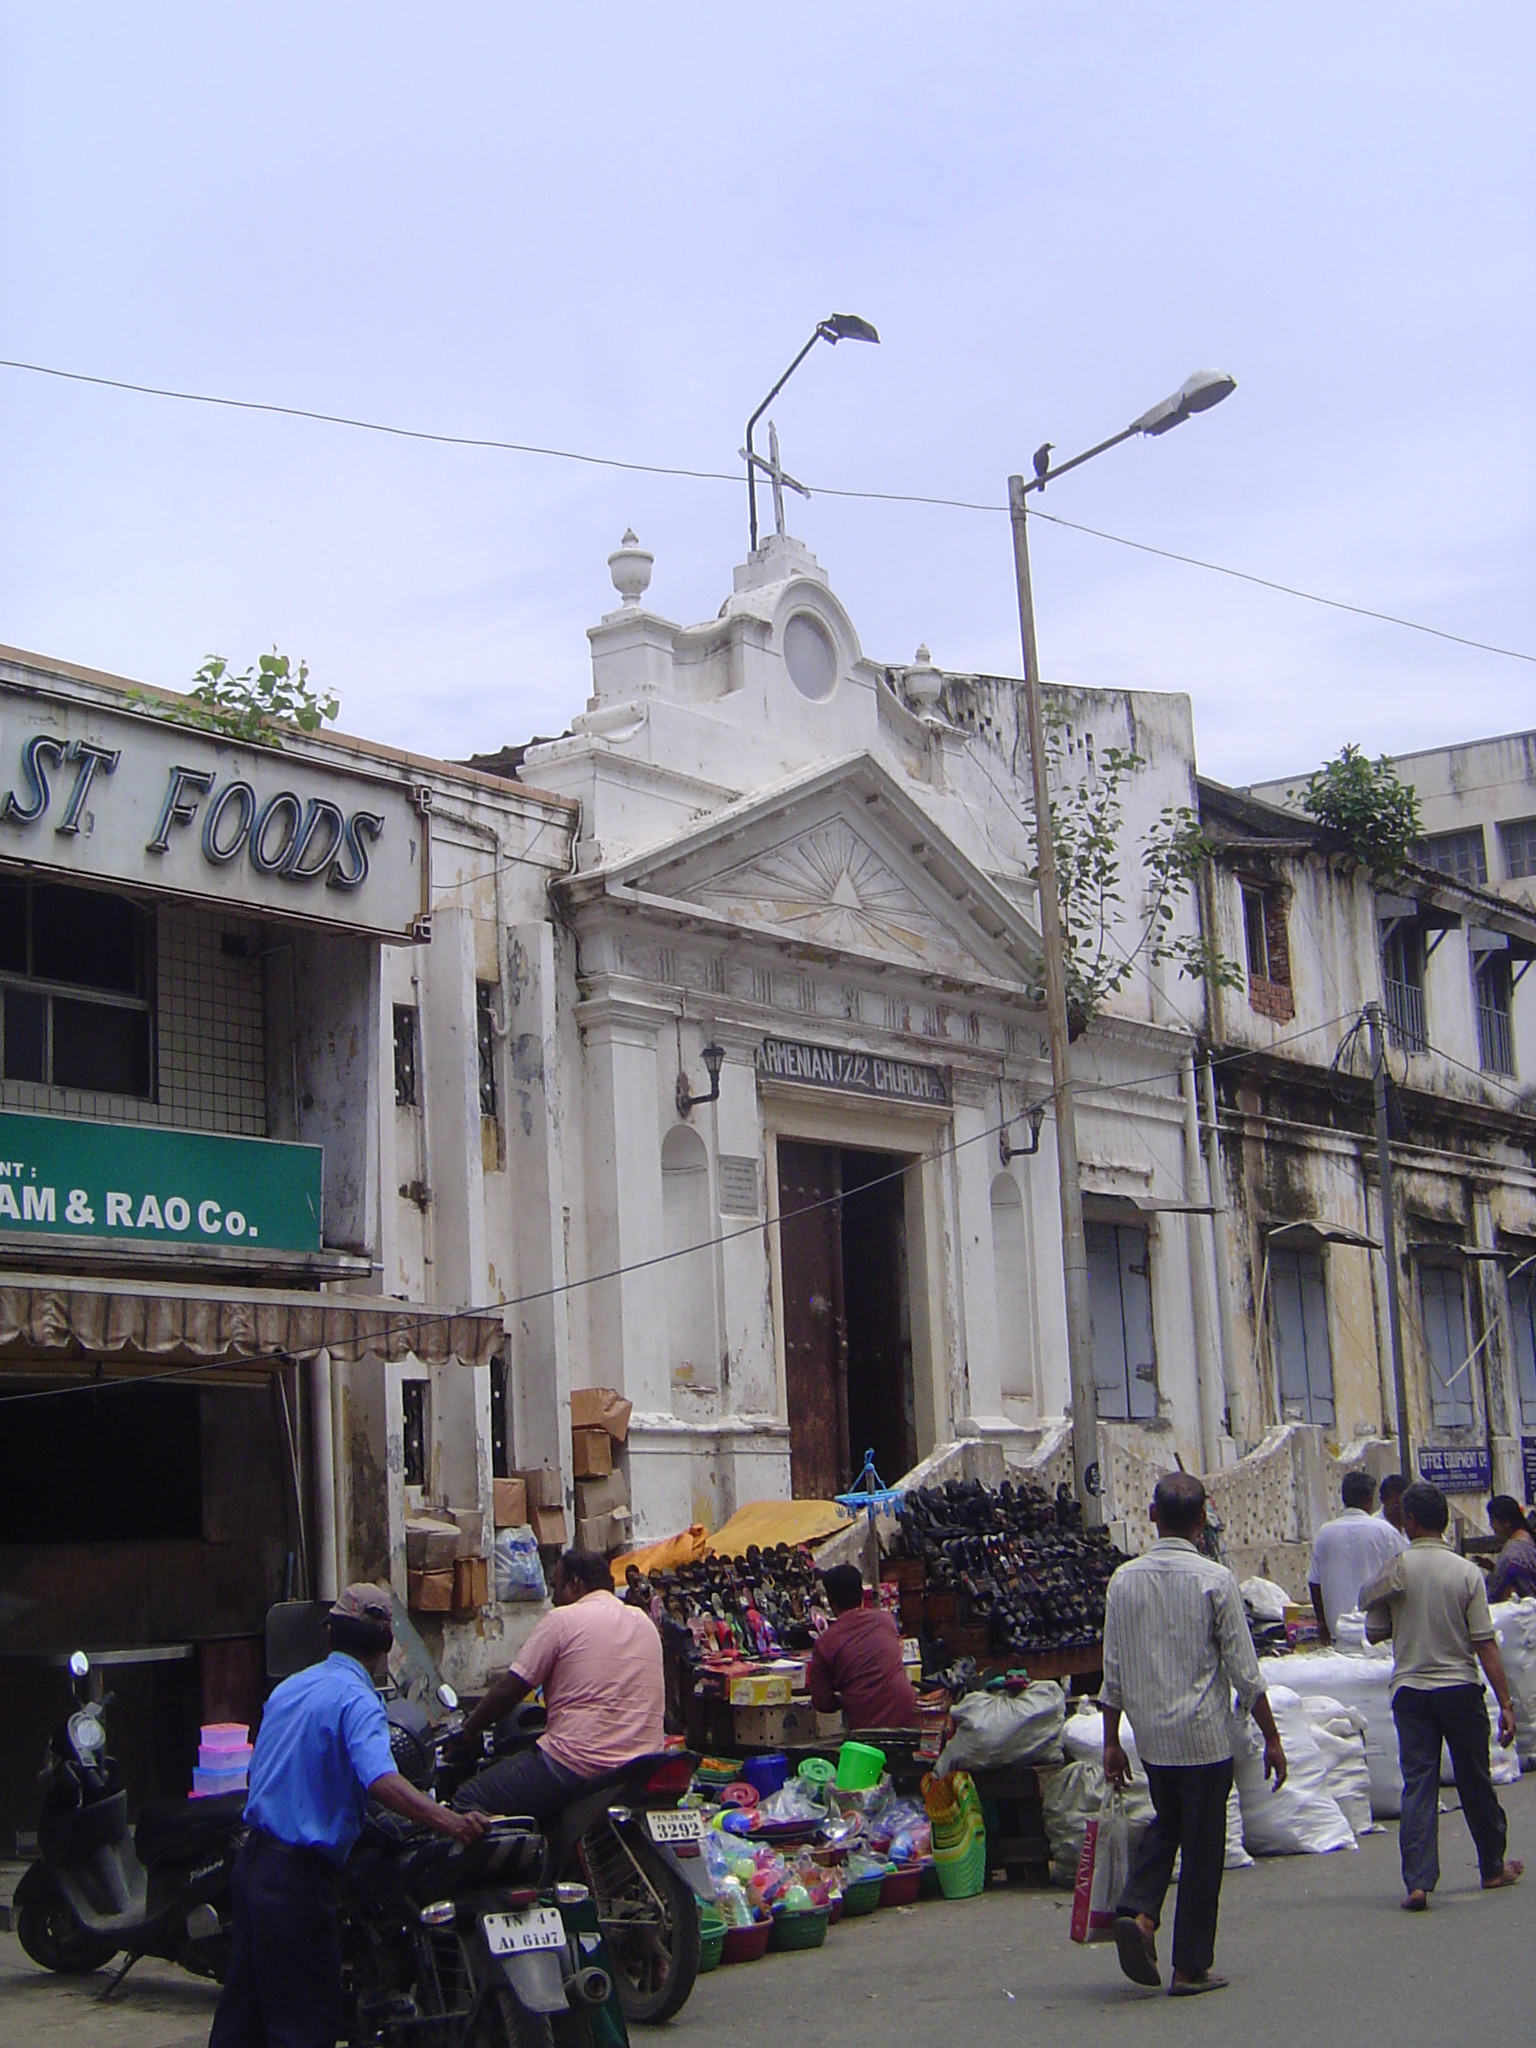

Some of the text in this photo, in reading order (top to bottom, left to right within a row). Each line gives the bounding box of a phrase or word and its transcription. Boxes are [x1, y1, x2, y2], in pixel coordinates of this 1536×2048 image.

[0, 734, 386, 890] ST FOODS
[756, 1040, 929, 1097] ARMENIAN 1712 CHURCH
[64, 1189, 96, 1225] &
[105, 1191, 191, 1231] RAO
[197, 1200, 259, 1237] Co.
[1420, 1452, 1444, 1470] OFFICE
[1444, 1451, 1478, 1469] EQUIPMENT
[656, 1822, 701, 1838] 3292
